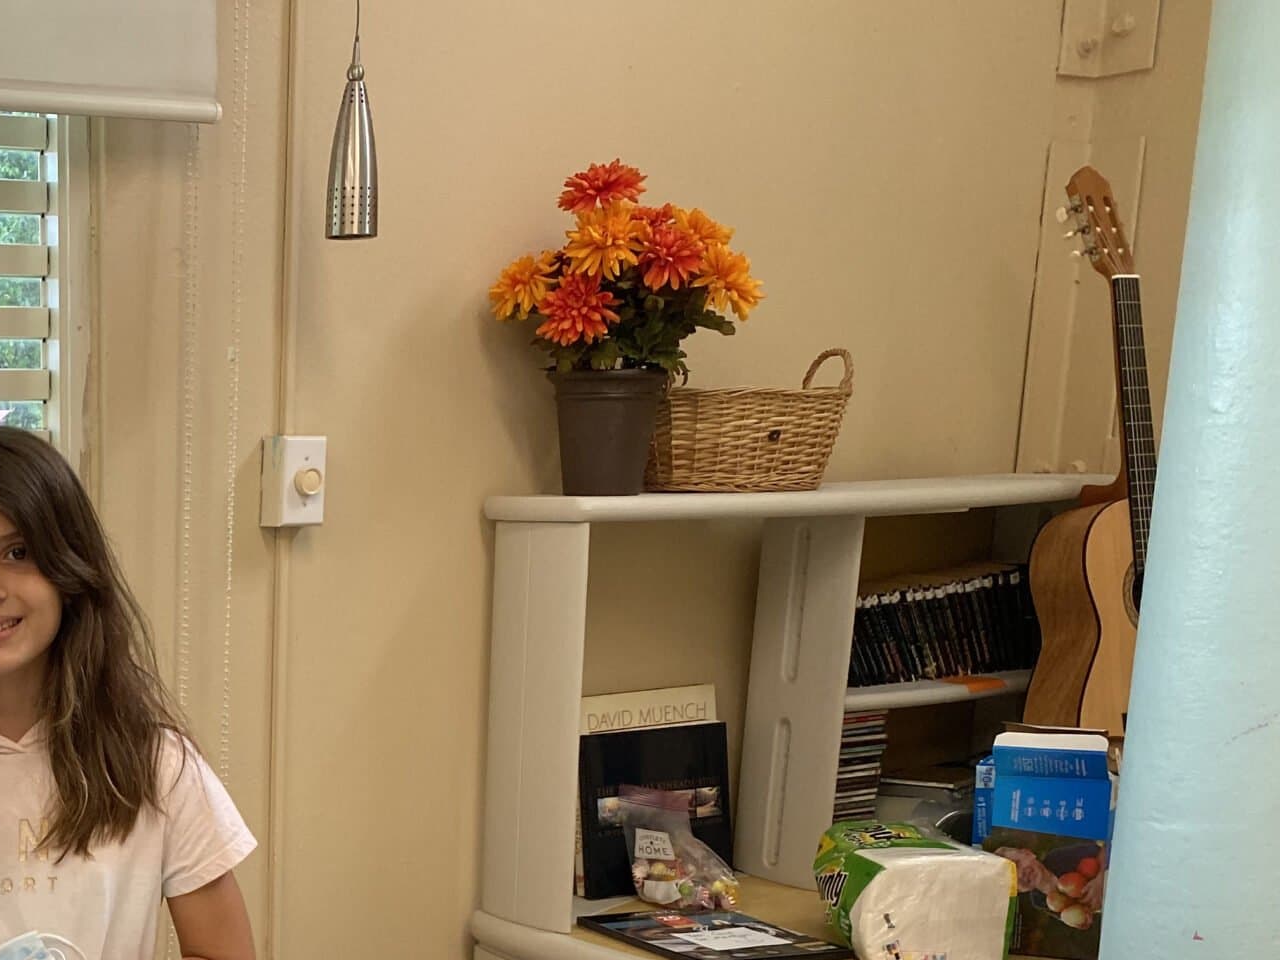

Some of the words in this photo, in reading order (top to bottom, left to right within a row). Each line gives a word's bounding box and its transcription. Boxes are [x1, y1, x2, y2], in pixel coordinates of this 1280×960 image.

[587, 710, 633, 731] DAVID
[638, 702, 706, 724] MUENCH
[638, 846, 671, 857] HOME
